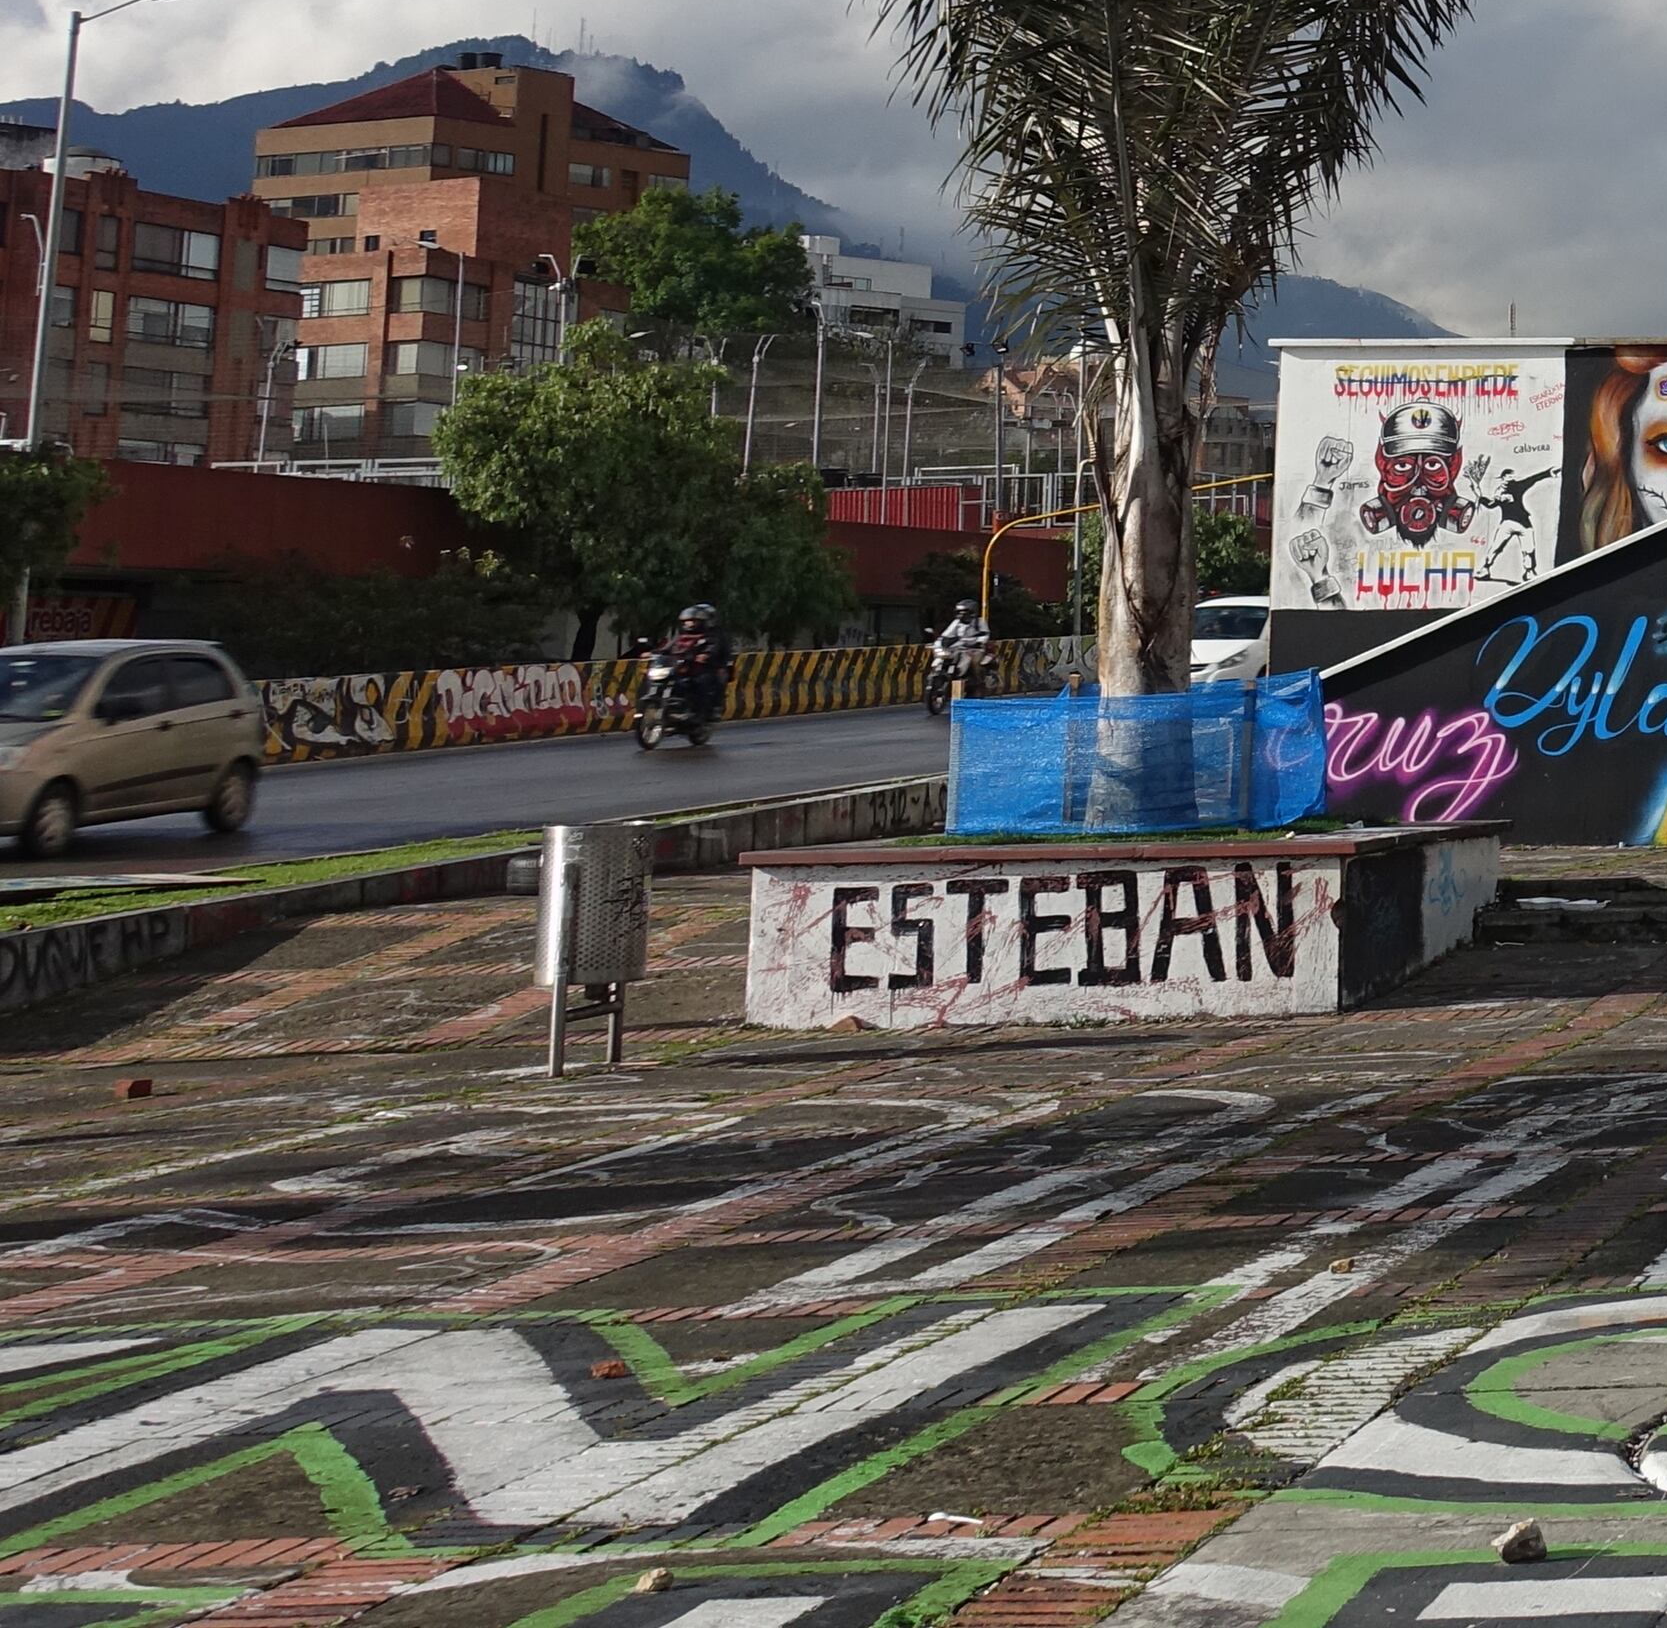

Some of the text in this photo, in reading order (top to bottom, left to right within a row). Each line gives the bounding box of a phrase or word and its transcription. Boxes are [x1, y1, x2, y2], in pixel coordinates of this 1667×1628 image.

[1334, 364, 1433, 398] SEGUIMOS
[1357, 551, 1476, 596] LUCHA
[830, 861, 1294, 994] ESTEBAN
